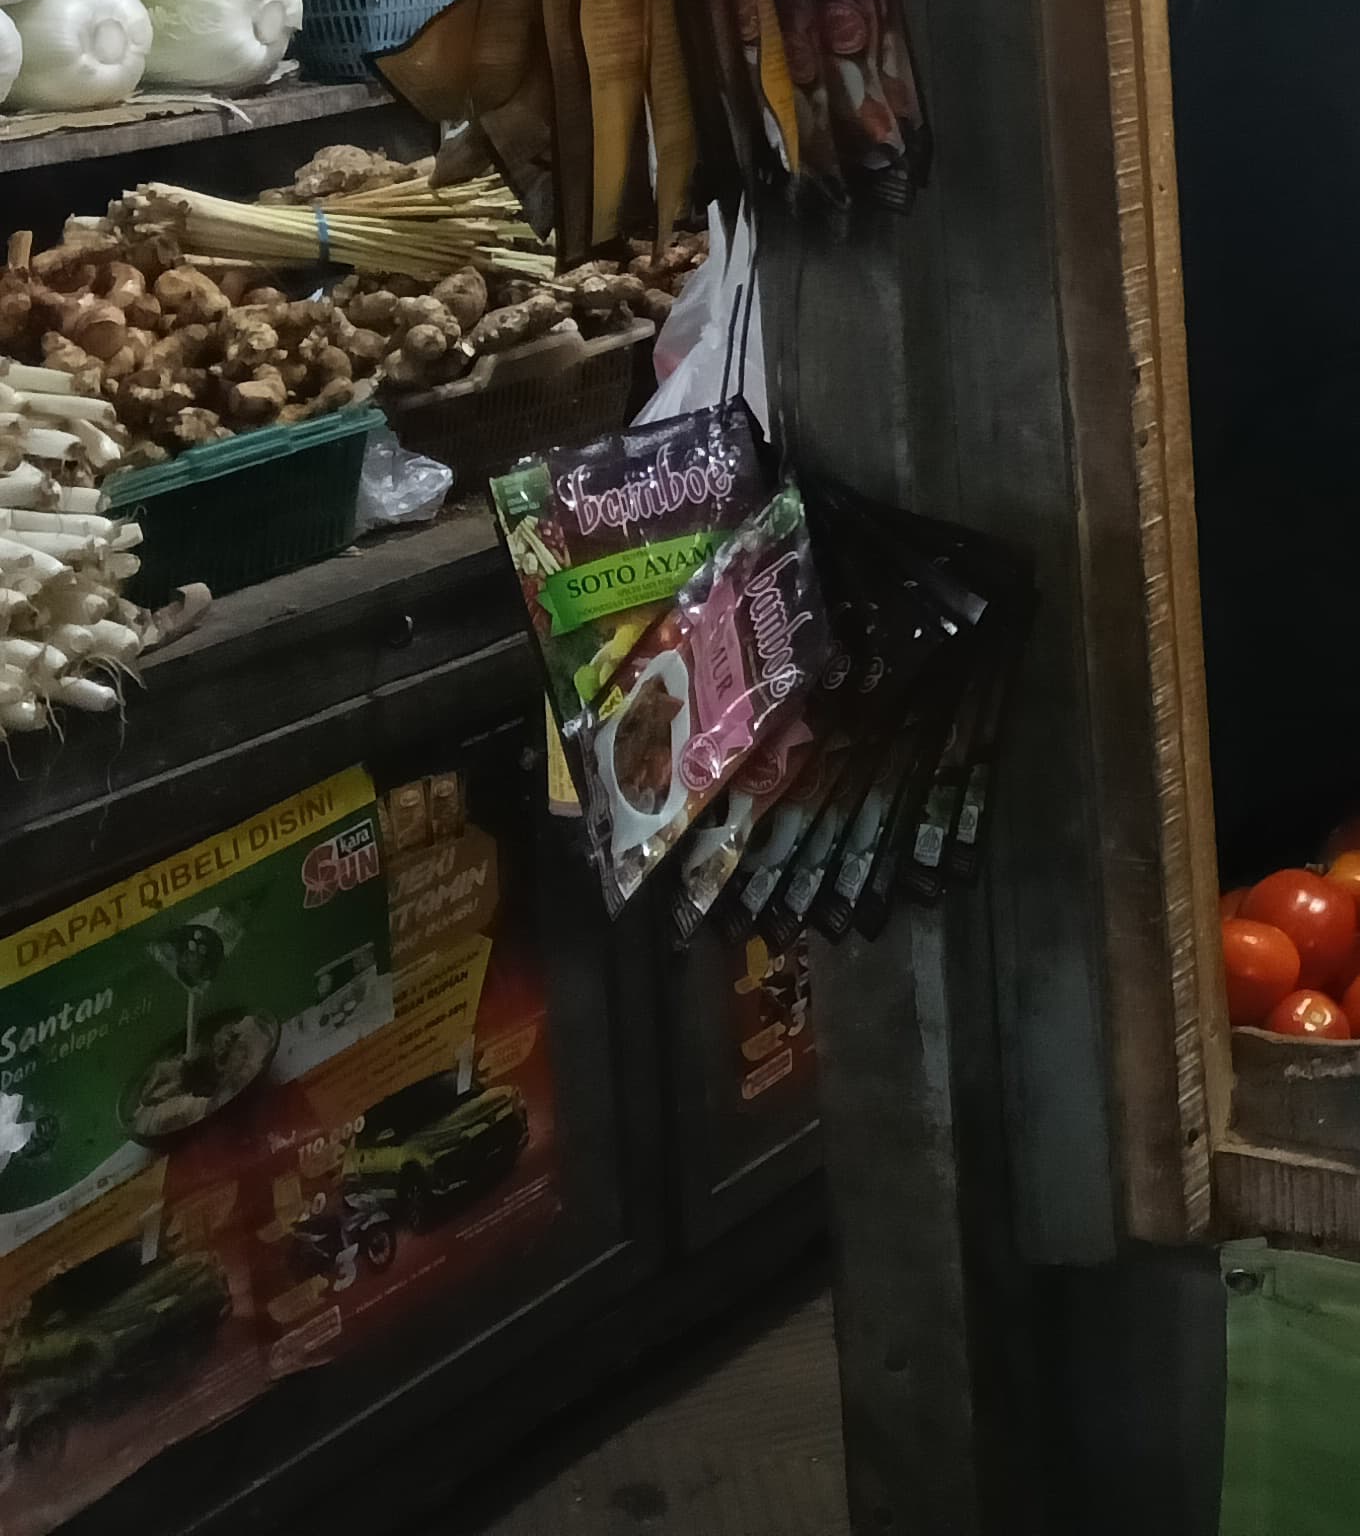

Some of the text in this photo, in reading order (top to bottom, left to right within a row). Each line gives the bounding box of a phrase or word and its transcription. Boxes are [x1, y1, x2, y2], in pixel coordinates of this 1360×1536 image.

[556, 441, 738, 536] bamboe
[566, 564, 636, 599] SOTO
[643, 541, 716, 579] AYAM
[744, 551, 813, 699] bamboe
[16, 789, 335, 967] DAPAT DIBELI DISINI
[302, 842, 380, 909] SUN
[339, 826, 371, 856] kara
[0, 986, 113, 1063] Santan
